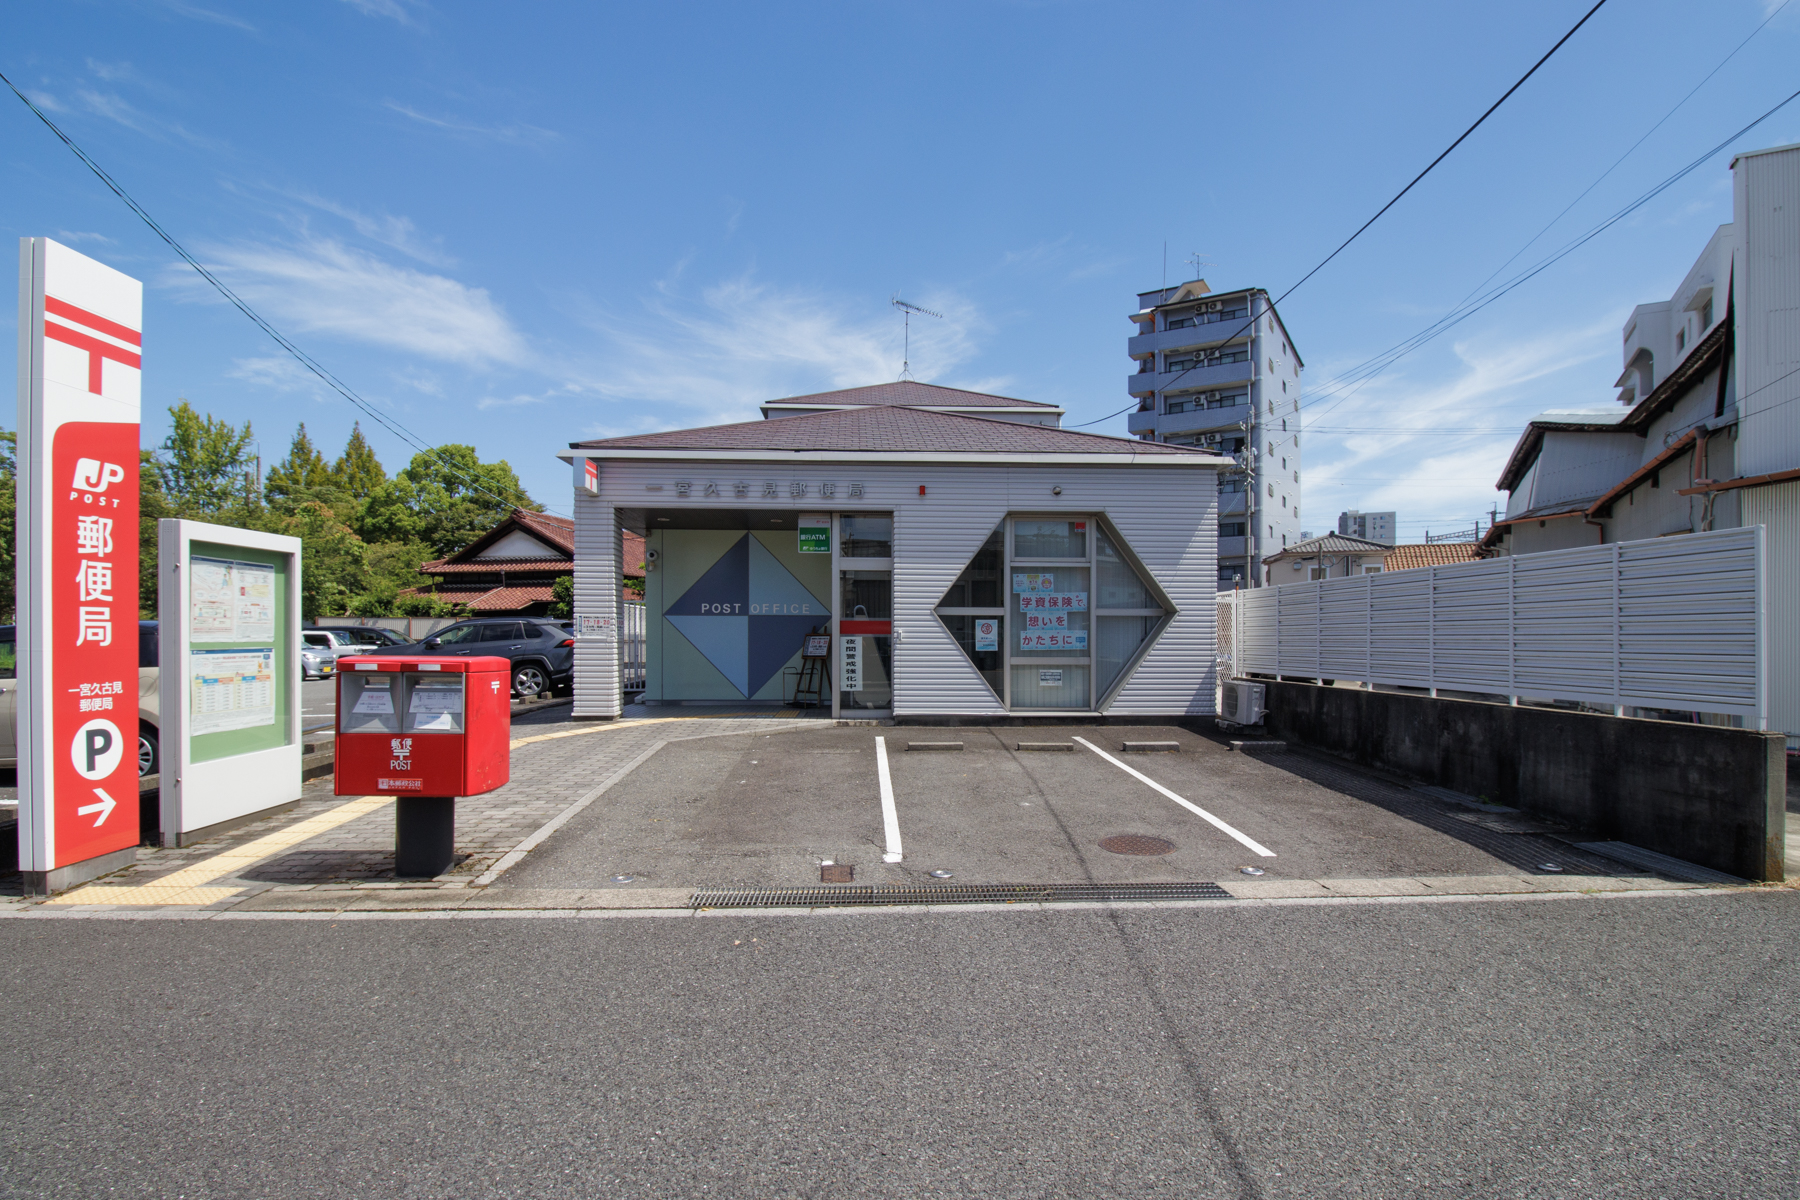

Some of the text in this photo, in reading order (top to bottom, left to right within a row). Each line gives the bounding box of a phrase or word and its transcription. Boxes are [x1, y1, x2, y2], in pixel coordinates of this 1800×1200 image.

[645, 480, 865, 499] 一宮久古見郵便局
[69, 491, 120, 508] POST
[75, 515, 113, 647] 郵便局
[701, 603, 811, 614] POST OFFICE
[1021, 597, 1086, 608] 学資保険で、
[1028, 616, 1066, 627] 想いを
[1022, 635, 1073, 646] かたちに
[845, 638, 857, 690] 夜間警戒強化中
[67, 681, 123, 697] 一宮久古見
[79, 697, 113, 712] 郵便局
[86, 728, 112, 772] P
[390, 738, 412, 750] 郵便
[390, 760, 412, 771] POST
